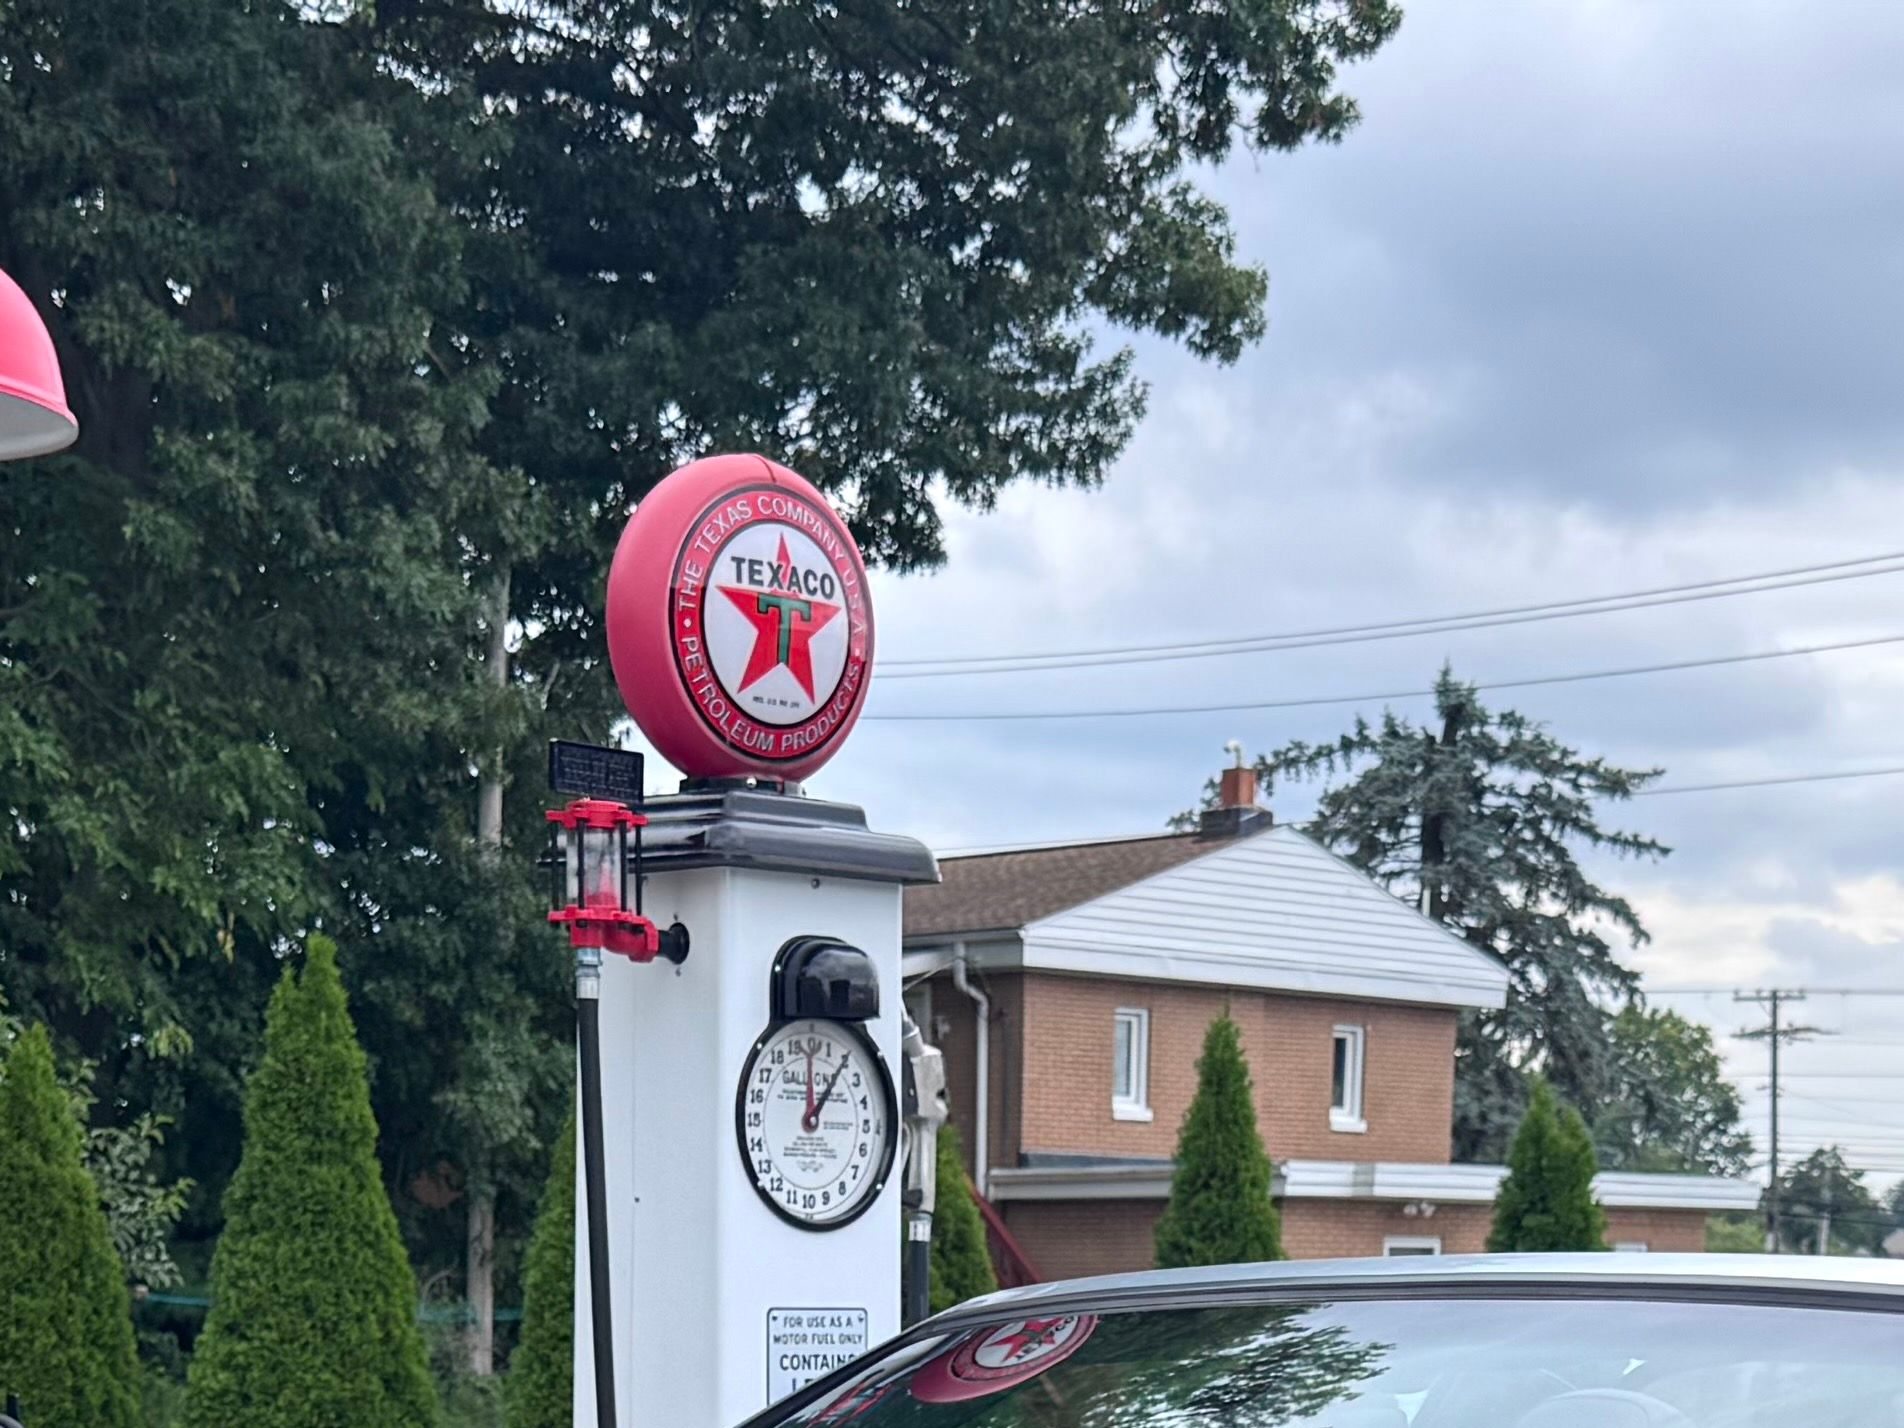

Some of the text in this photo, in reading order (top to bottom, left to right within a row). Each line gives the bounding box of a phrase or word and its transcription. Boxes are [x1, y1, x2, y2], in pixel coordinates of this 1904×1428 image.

[678, 560, 703, 612] THE
[694, 501, 753, 554] TEXAS
[758, 496, 845, 561] COMPANY
[730, 556, 835, 600] TEXACO
[682, 634, 859, 752] PETROLEUM PRODUCTS
[771, 1050, 784, 1065] 18
[759, 1068, 772, 1083] 17
[852, 1073, 860, 1088] 3
[750, 1089, 764, 1104] 16
[860, 1095, 868, 1110] 4
[750, 1137, 763, 1152] 14
[859, 1142, 867, 1157] 6
[758, 1160, 771, 1174] 13
[851, 1165, 859, 1180] 7
[770, 1177, 783, 1192] 12
[838, 1181, 846, 1195] 8
[786, 1190, 798, 1205] 11
[802, 1194, 816, 1209] 10
[822, 1191, 830, 1205] 9
[784, 1316, 853, 1328] FOR USE AS A
[773, 1333, 862, 1345] MOTOR FUEL ONLY
